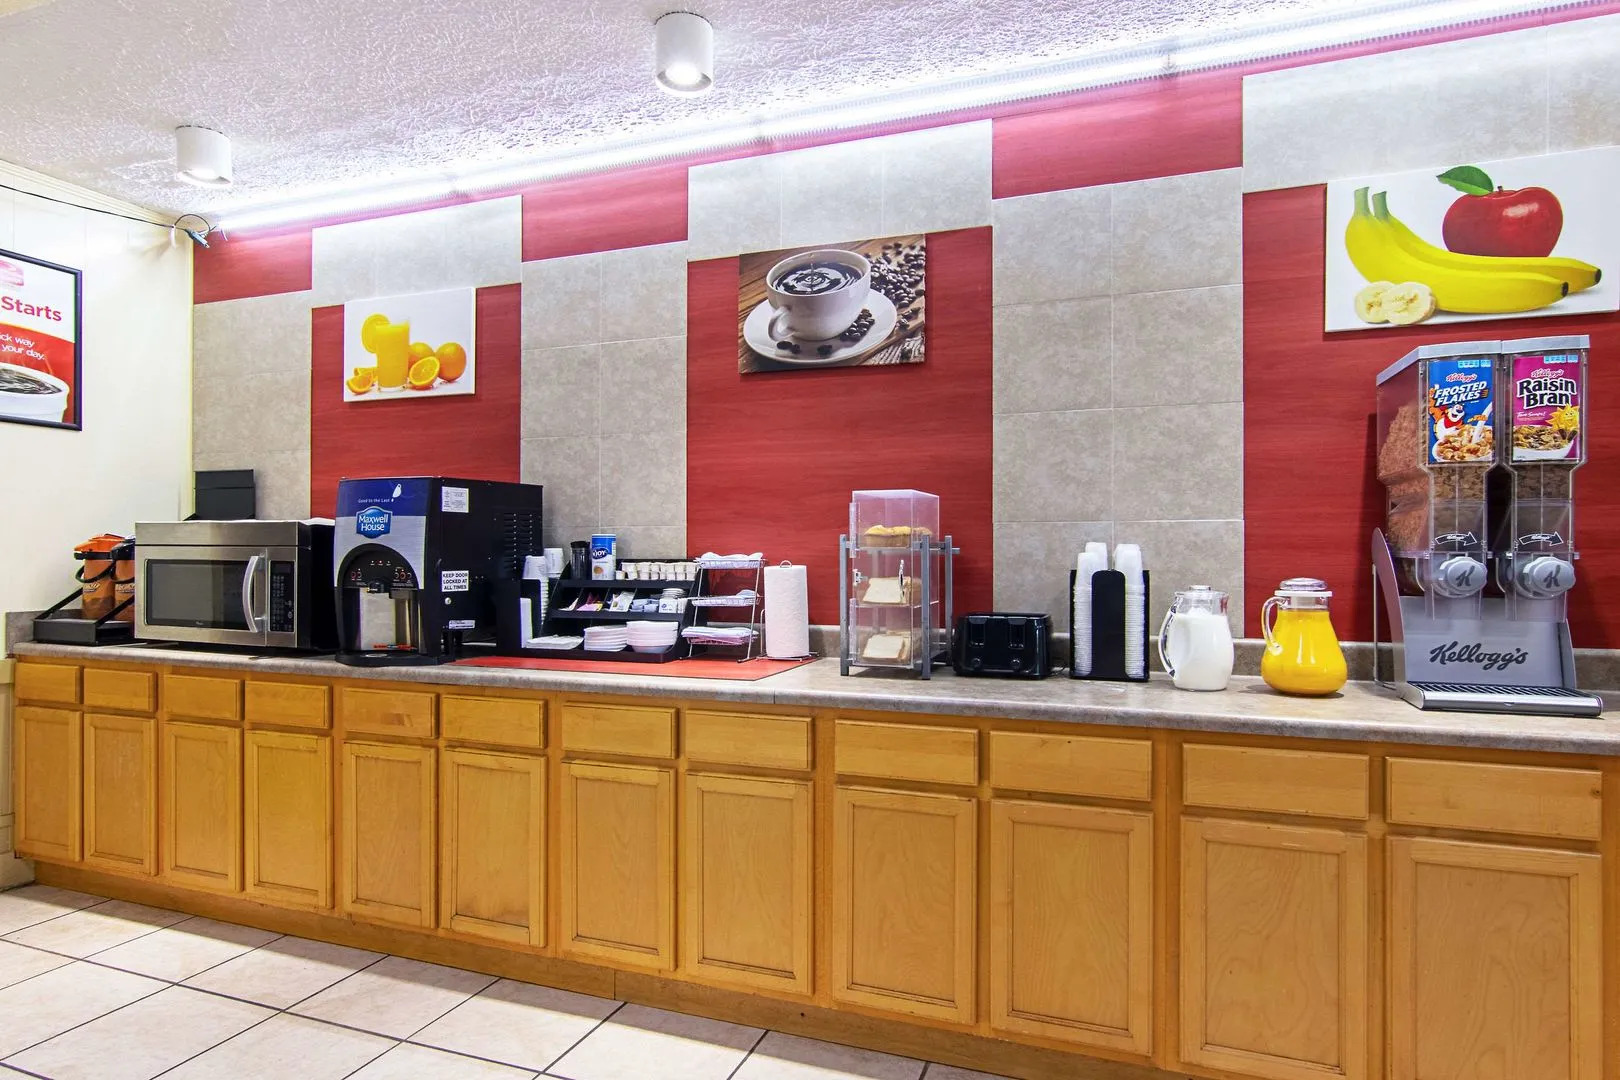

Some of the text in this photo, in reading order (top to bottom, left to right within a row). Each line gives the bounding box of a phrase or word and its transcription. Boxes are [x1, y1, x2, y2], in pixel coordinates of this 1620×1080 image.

[1, 296, 62, 321] Starts
[1, 343, 24, 354] your
[14, 336, 35, 348] way
[1434, 382, 1487, 399] FROSTED
[1518, 378, 1577, 397] Raisin
[1435, 390, 1481, 406] FLAKES
[1524, 391, 1571, 409] Bran
[358, 513, 388, 524] Maxwell
[360, 522, 384, 531] House
[1429, 641, 1528, 671] Kellogg's
